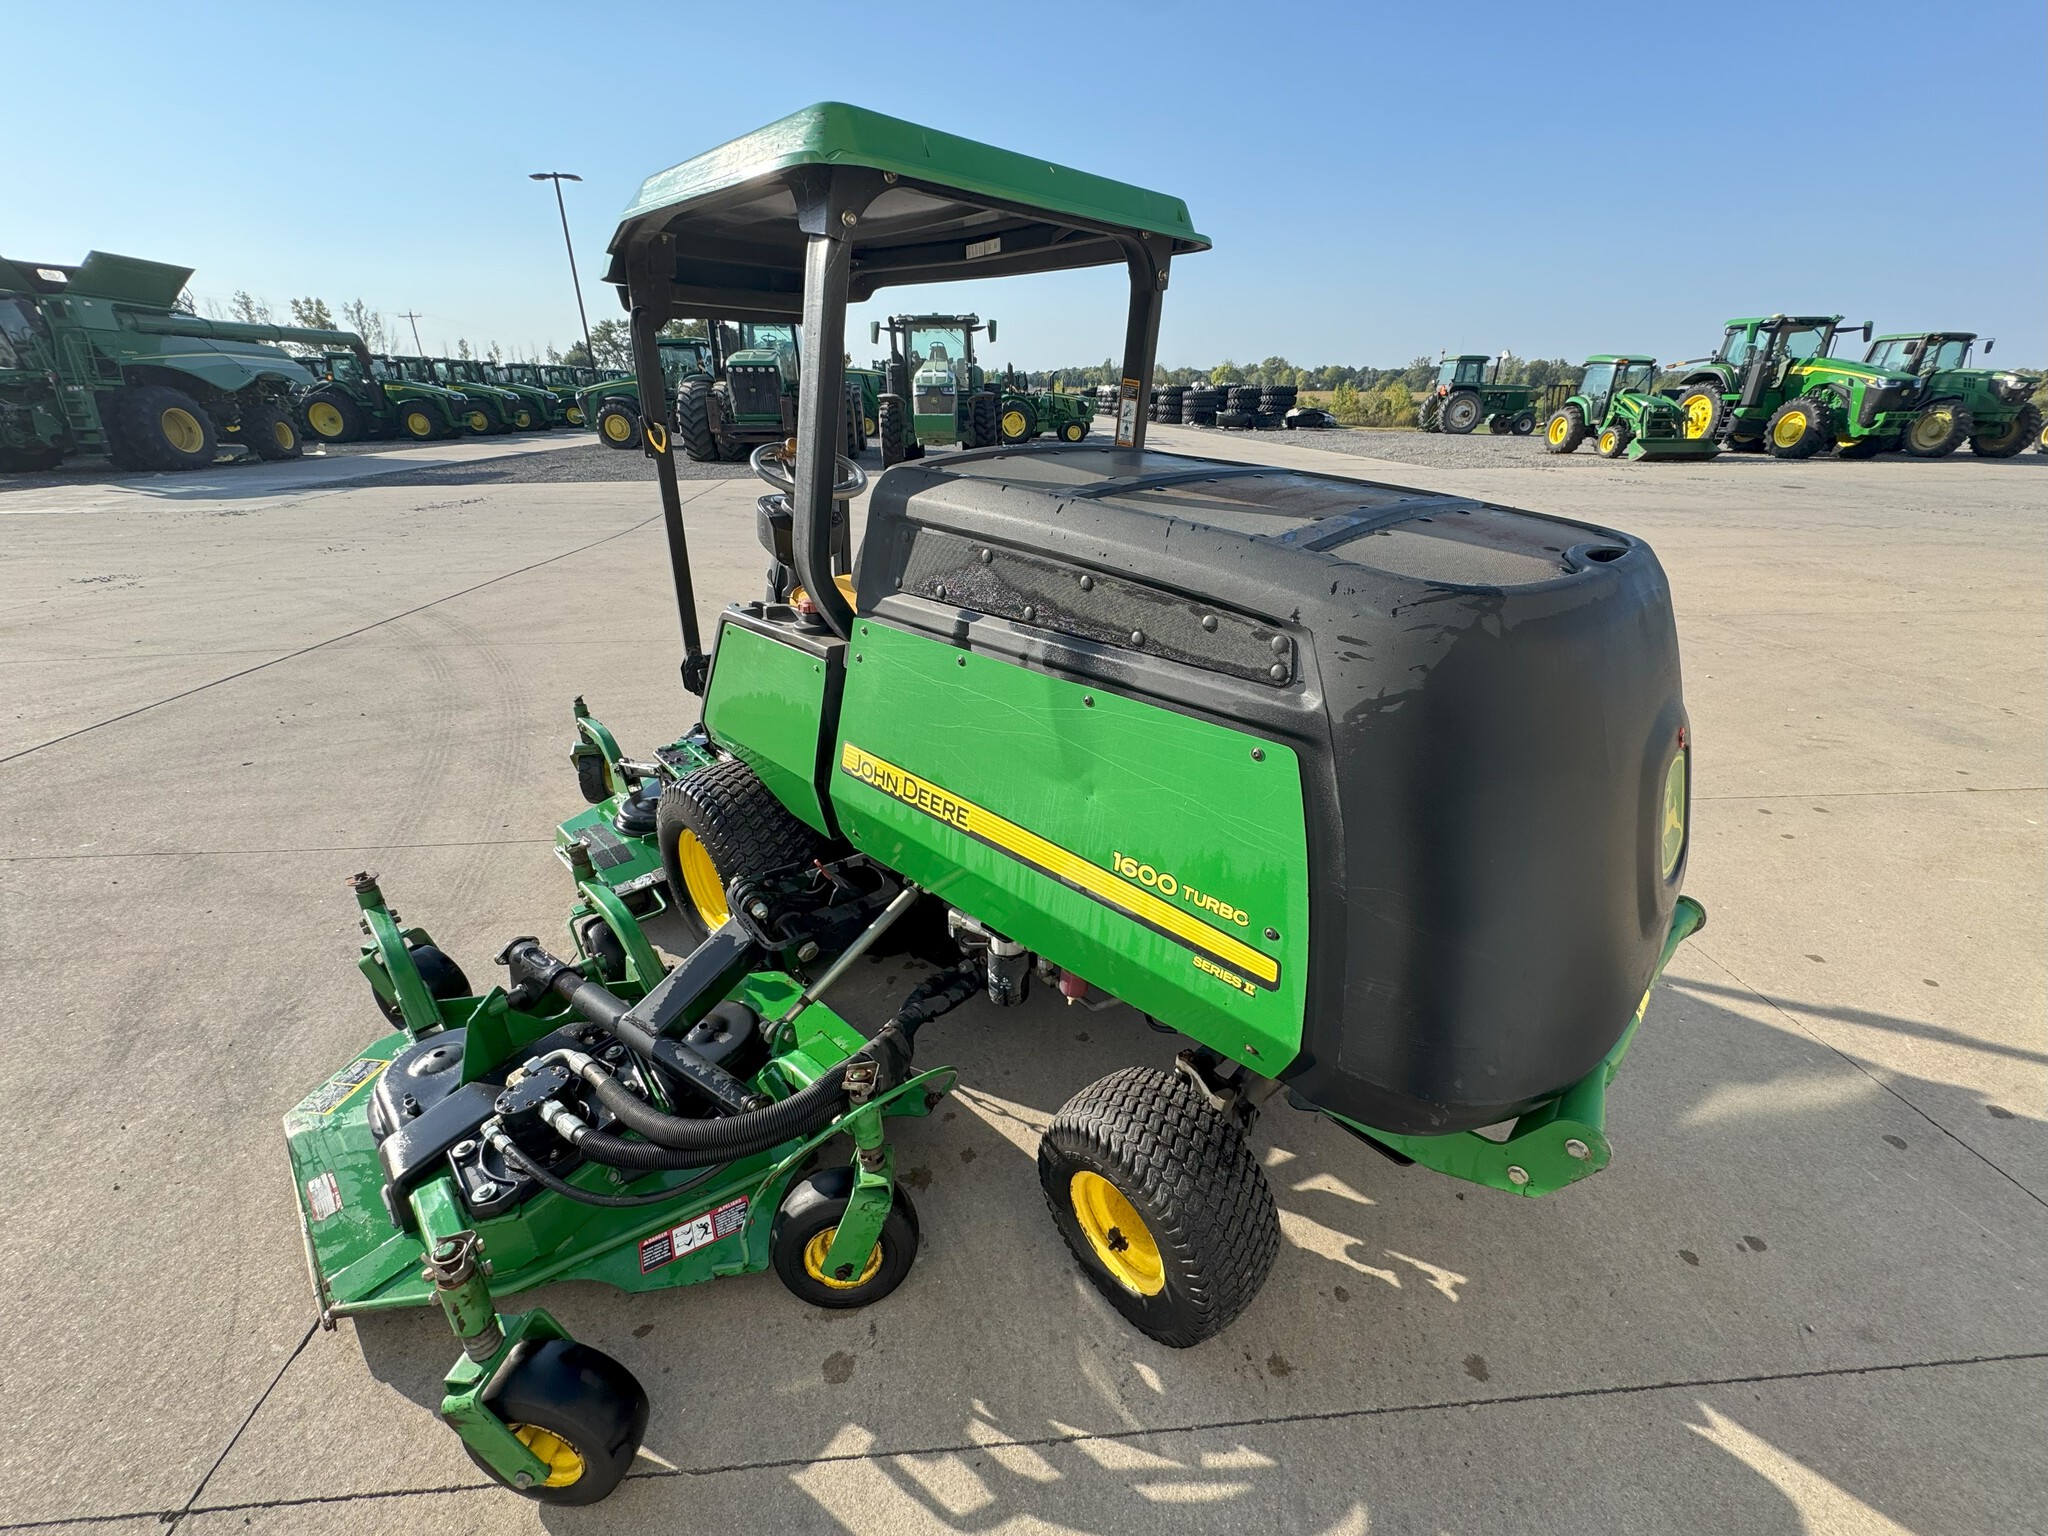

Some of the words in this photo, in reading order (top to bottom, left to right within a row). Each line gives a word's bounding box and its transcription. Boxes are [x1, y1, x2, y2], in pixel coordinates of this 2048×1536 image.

[851, 754, 899, 793] JOHN
[902, 776, 970, 828] DEERE
[1113, 850, 1178, 896] 1600
[1182, 884, 1250, 927] TURBO
[1192, 955, 1242, 990] SERIES
